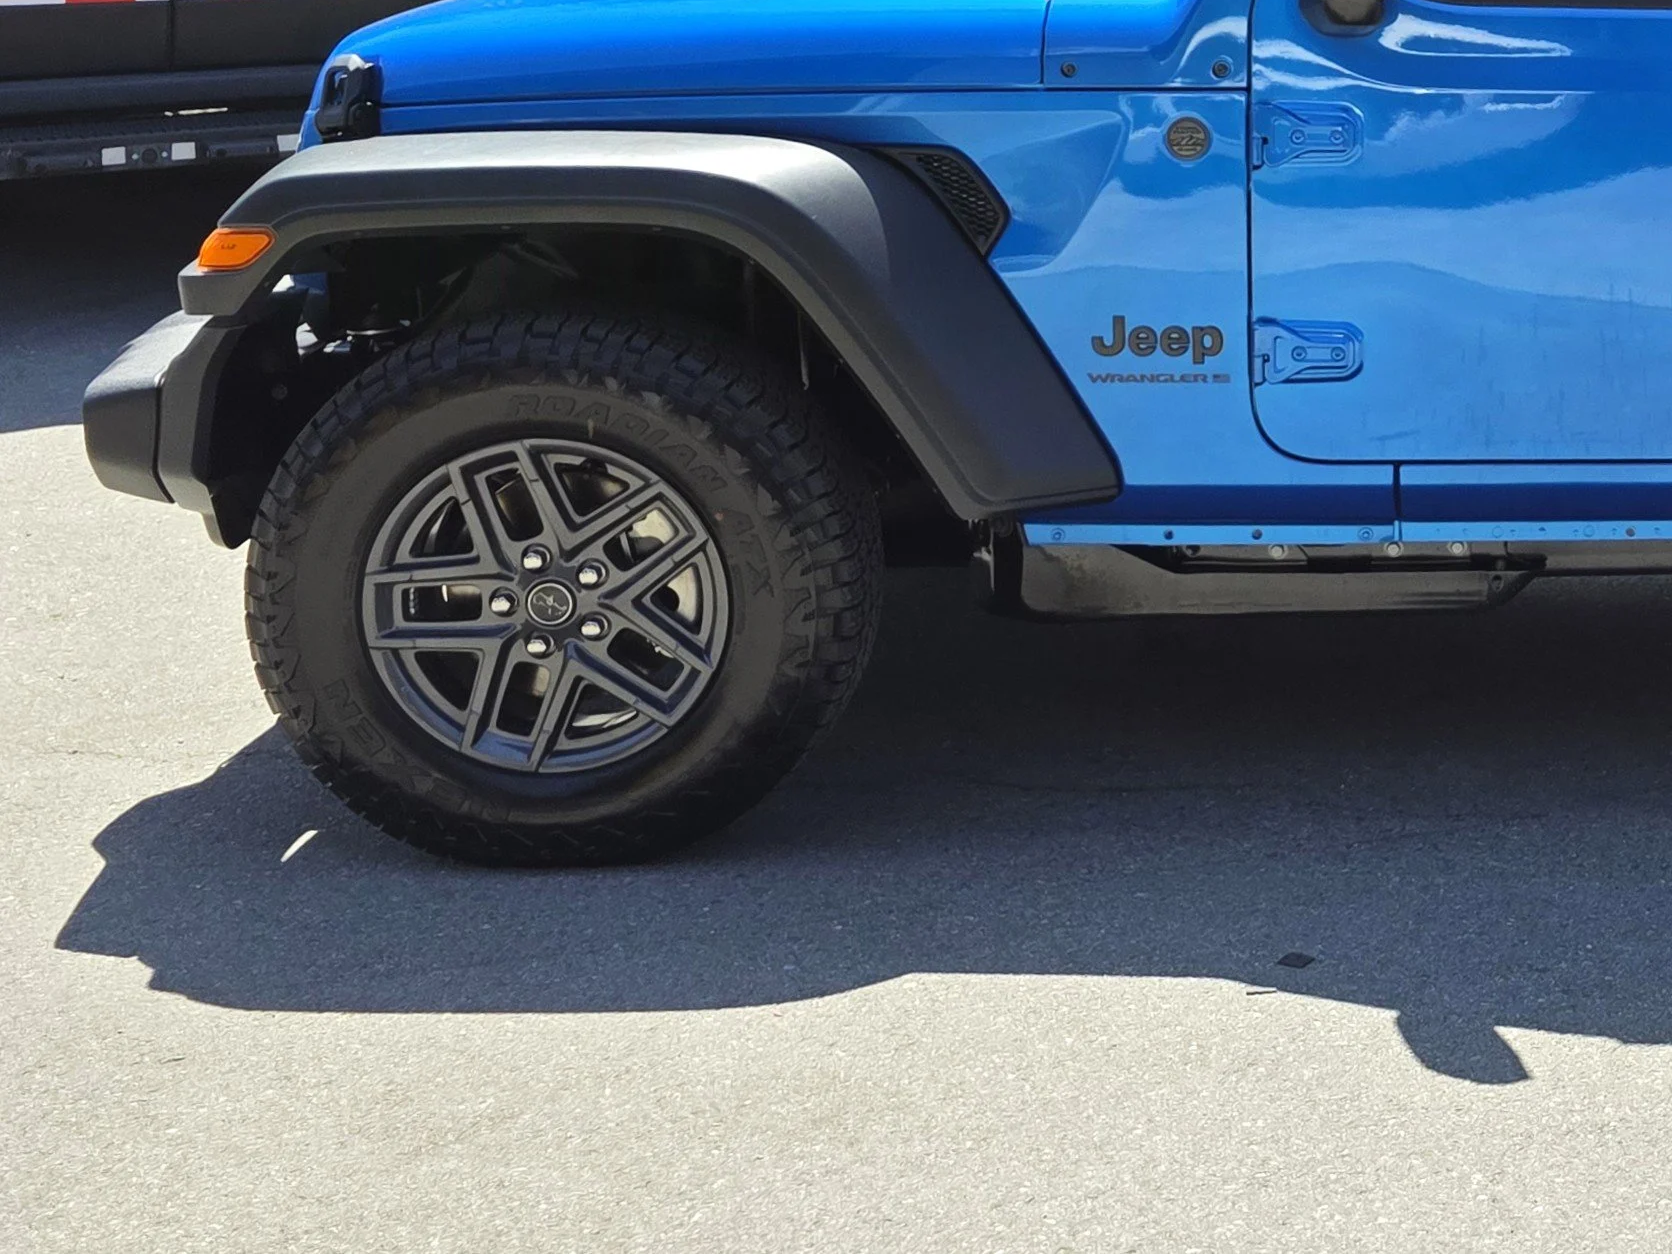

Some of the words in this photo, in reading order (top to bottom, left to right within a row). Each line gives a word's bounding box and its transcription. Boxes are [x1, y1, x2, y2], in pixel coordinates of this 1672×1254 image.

[1091, 314, 1224, 365] Jeep
[1087, 372, 1208, 383] WRANGLER
[510, 394, 729, 494] ROADIAN
